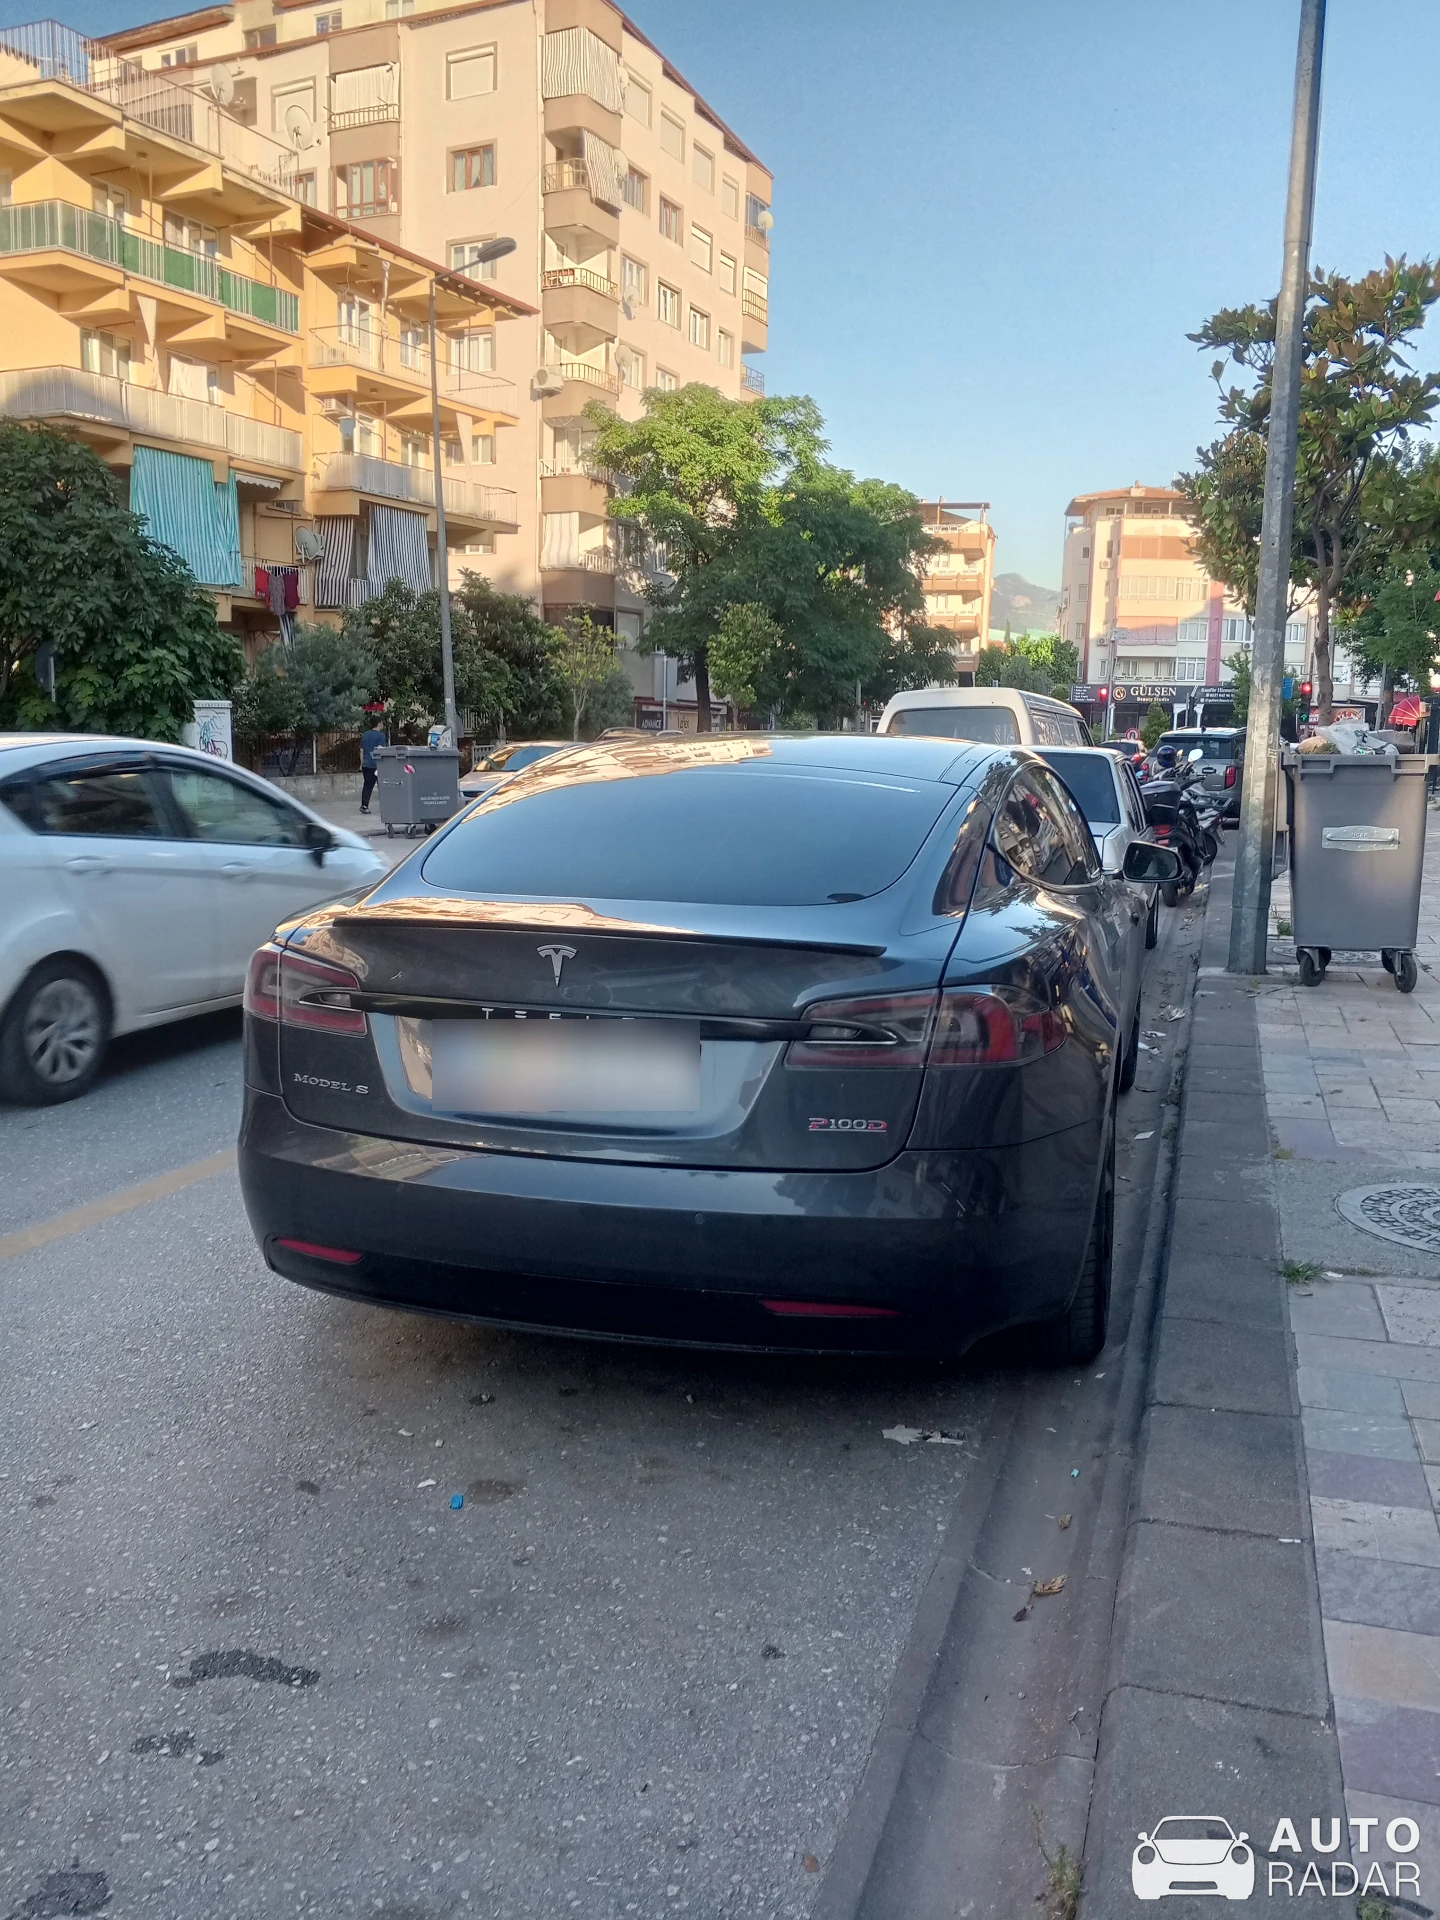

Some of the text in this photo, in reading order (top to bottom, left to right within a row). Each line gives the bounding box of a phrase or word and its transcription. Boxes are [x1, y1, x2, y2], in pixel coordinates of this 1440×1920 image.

[641, 718, 662, 729] ADVANCE
[481, 1007, 636, 1020] TES
[293, 1073, 369, 1094] MODEL S
[808, 1117, 888, 1131] P100D
